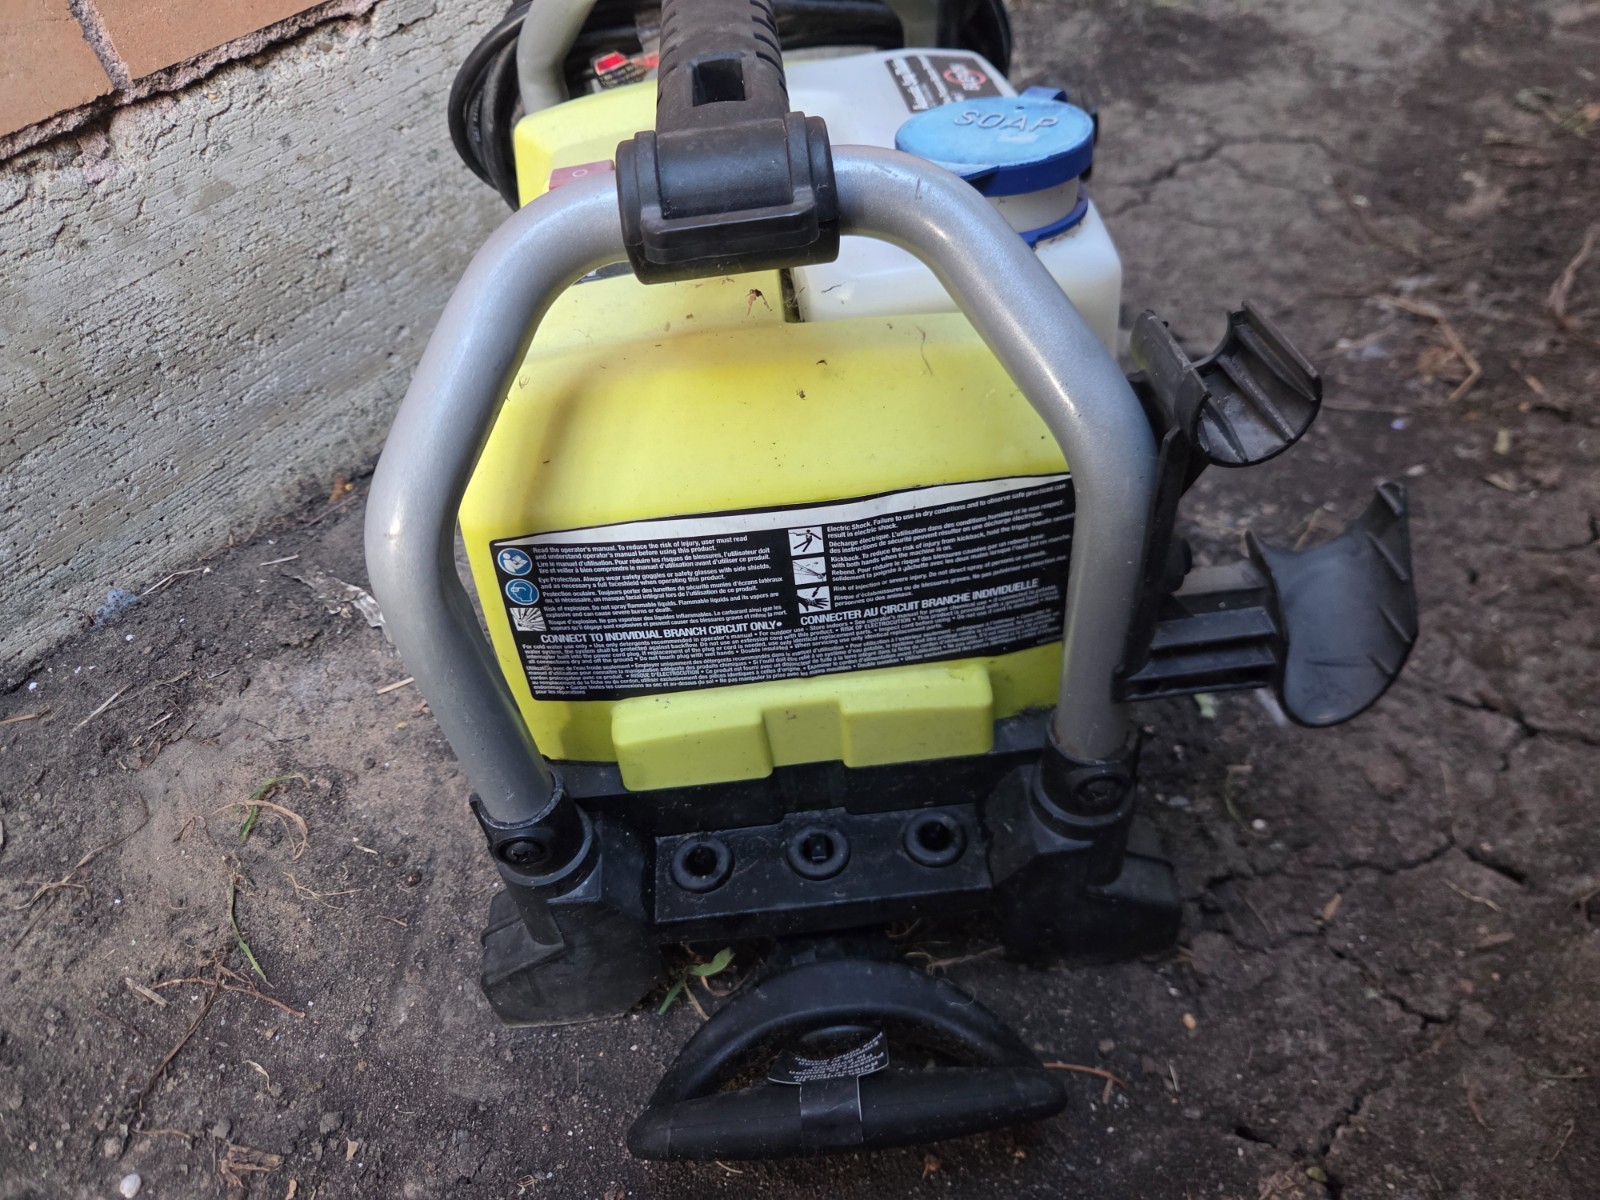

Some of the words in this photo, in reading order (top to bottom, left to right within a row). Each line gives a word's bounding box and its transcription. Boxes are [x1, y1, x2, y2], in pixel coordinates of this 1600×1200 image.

[952, 108, 1058, 133] SOAP
[852, 521, 872, 530] Shock.
[874, 518, 894, 526] Failure
[934, 504, 966, 515] conditions
[987, 495, 1010, 504] observe
[828, 530, 846, 538] result
[854, 526, 876, 535] electric
[878, 522, 899, 531] shock.
[561, 546, 591, 554] operator's
[583, 552, 613, 560] operator's
[691, 544, 717, 554] product.
[724, 549, 757, 557] l'utilisateur
[910, 549, 935, 557] machine
[594, 565, 629, 573] comprendre
[748, 553, 771, 563] produit.
[642, 572, 666, 580] goggles
[658, 577, 687, 585] operating
[700, 573, 727, 582] product.
[800, 610, 861, 625] CONNECTER
[864, 608, 878, 617] AU
[880, 602, 919, 615] CIRCUIT
[922, 593, 970, 609] BRANCHE
[972, 579, 1039, 600] INDIVIDUELLE
[541, 634, 587, 643] CONNECT
[590, 633, 603, 642] TO
[605, 630, 661, 641] INDIVIDUAL
[664, 626, 706, 637] BRANCH
[709, 623, 748, 634] CIRCUIT
[750, 621, 777, 631] ONLY
